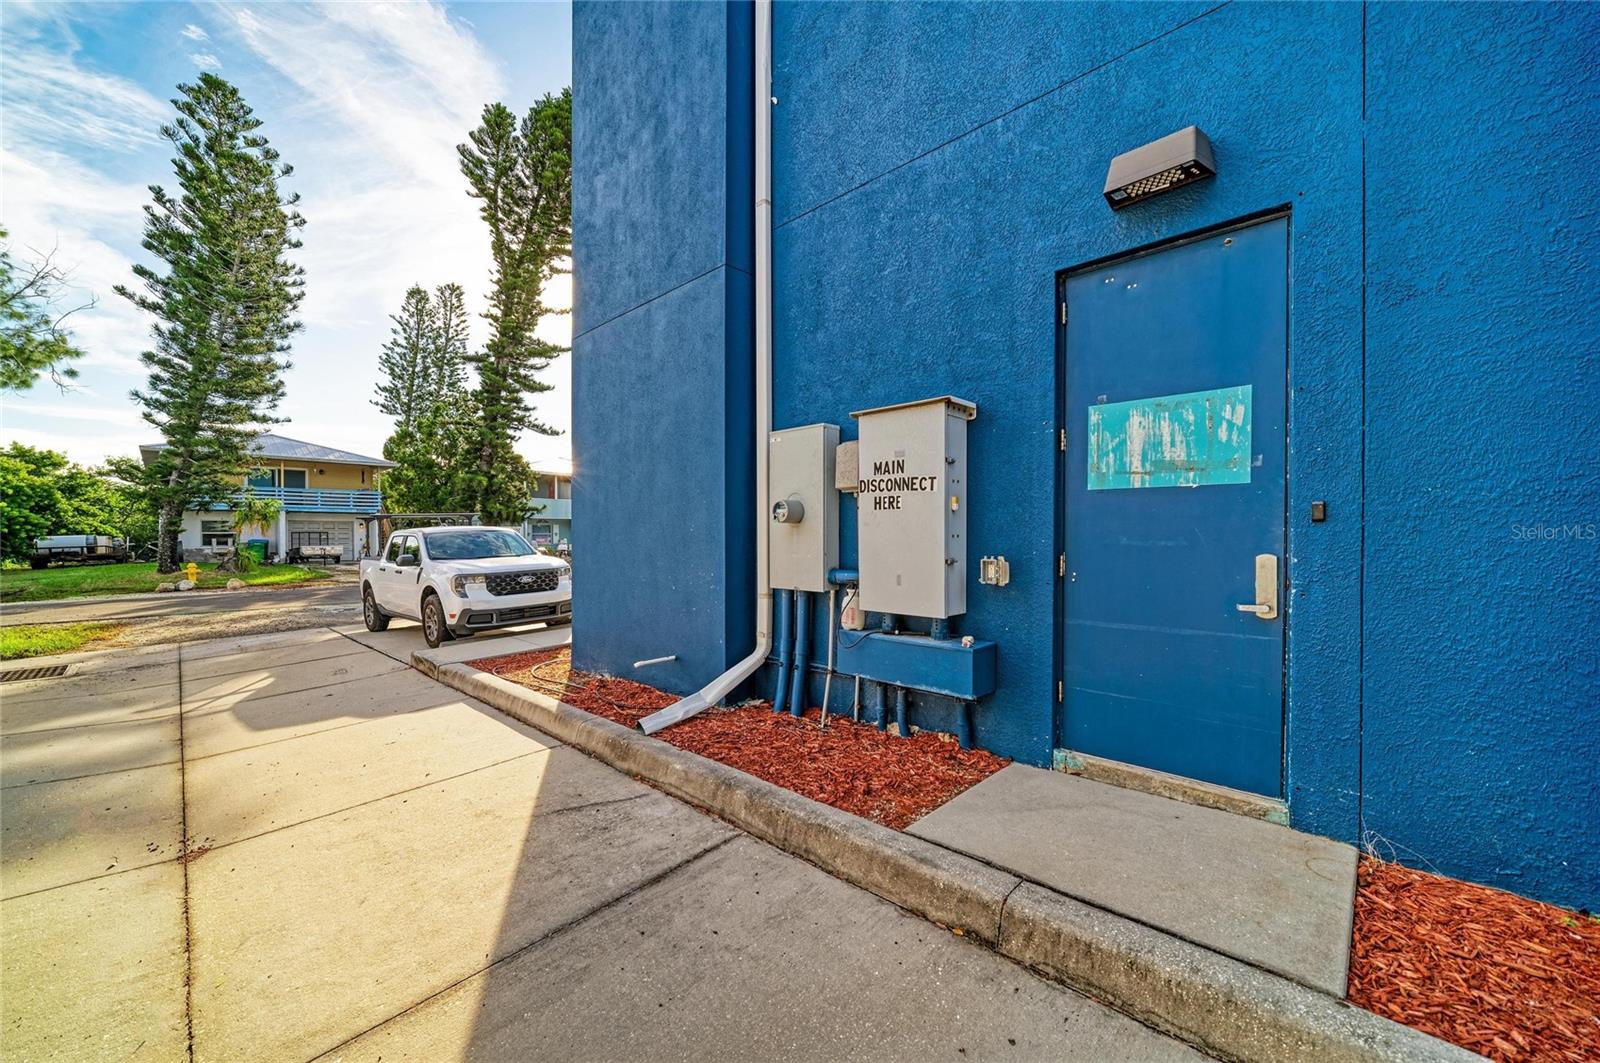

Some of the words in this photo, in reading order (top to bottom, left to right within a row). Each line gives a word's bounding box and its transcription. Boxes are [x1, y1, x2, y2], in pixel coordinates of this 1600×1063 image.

[873, 459, 905, 475] MAIN
[859, 476, 937, 493] DISCONNECT
[873, 495, 902, 510] HERE
